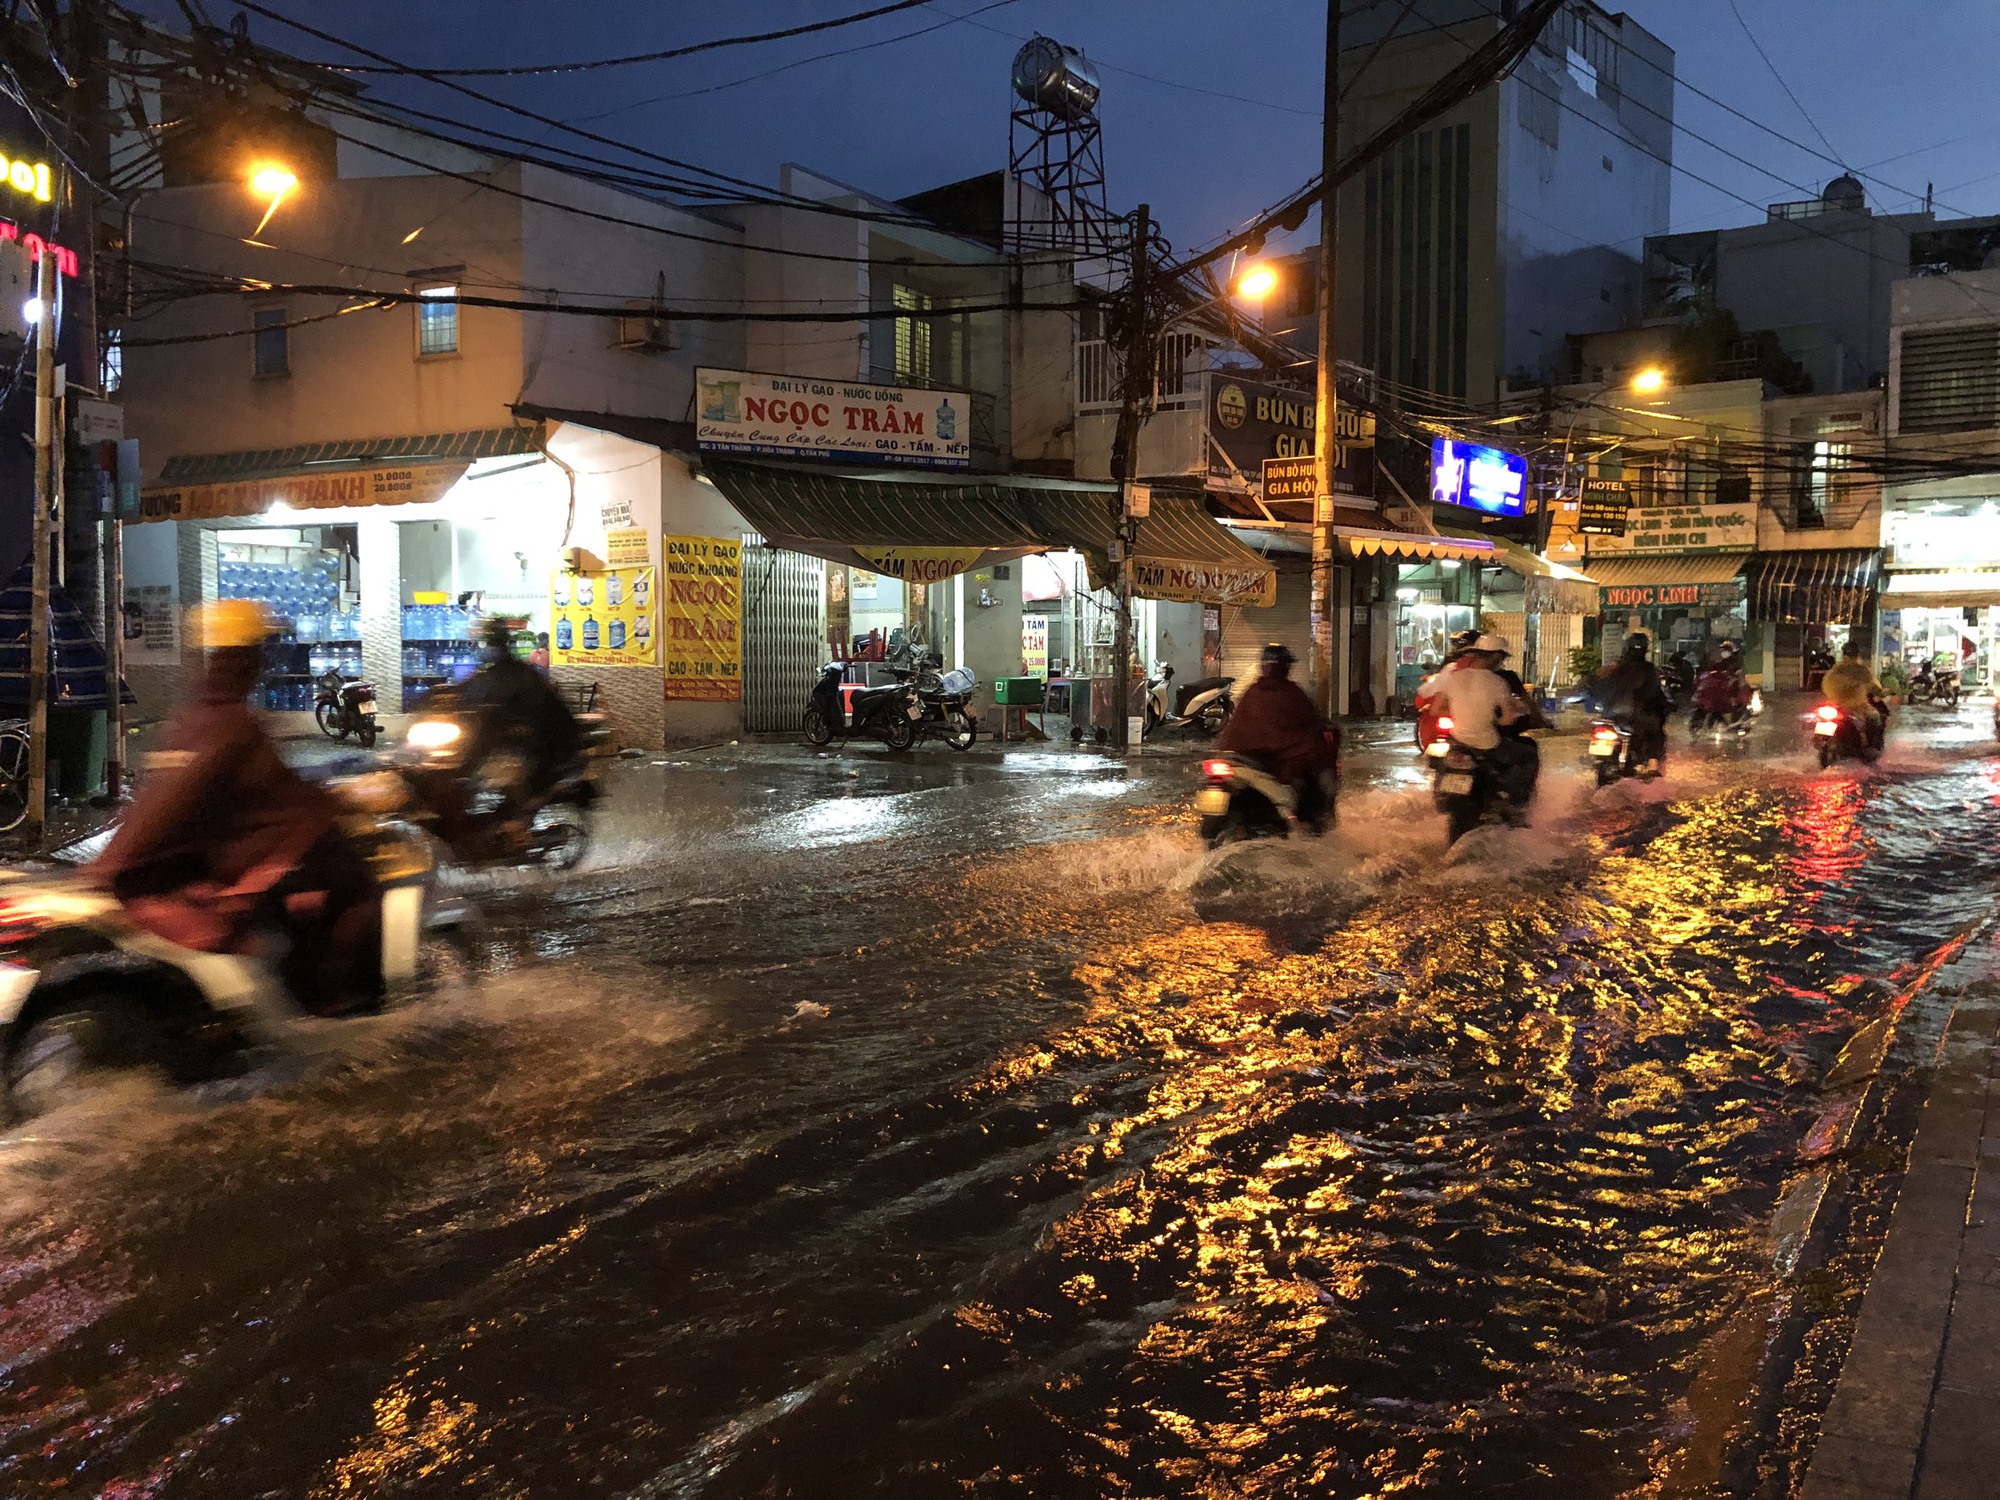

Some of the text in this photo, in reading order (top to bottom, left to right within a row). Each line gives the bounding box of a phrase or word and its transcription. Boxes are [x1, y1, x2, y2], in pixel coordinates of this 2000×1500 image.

[811, 384, 834, 397] GẠO
[744, 396, 924, 435] NGỌC TRÂM
[748, 430, 780, 444] Cung
[875, 439, 898, 452] GẠO
[909, 439, 934, 453] TẤM
[946, 442, 968, 455] NẾP
[1267, 464, 1285, 479] BÚN
[1286, 462, 1299, 478] BÒ
[1268, 482, 1290, 495] GIA
[1293, 478, 1315, 496] HỘI
[1588, 481, 1626, 492] HOTEL
[669, 541, 737, 560] ĐẠI LÝ GẠO
[1137, 561, 1164, 587] TẤM
[669, 578, 738, 612] NGỌC
[1607, 587, 1653, 608] NGỌC
[668, 613, 738, 642] TRÂM
